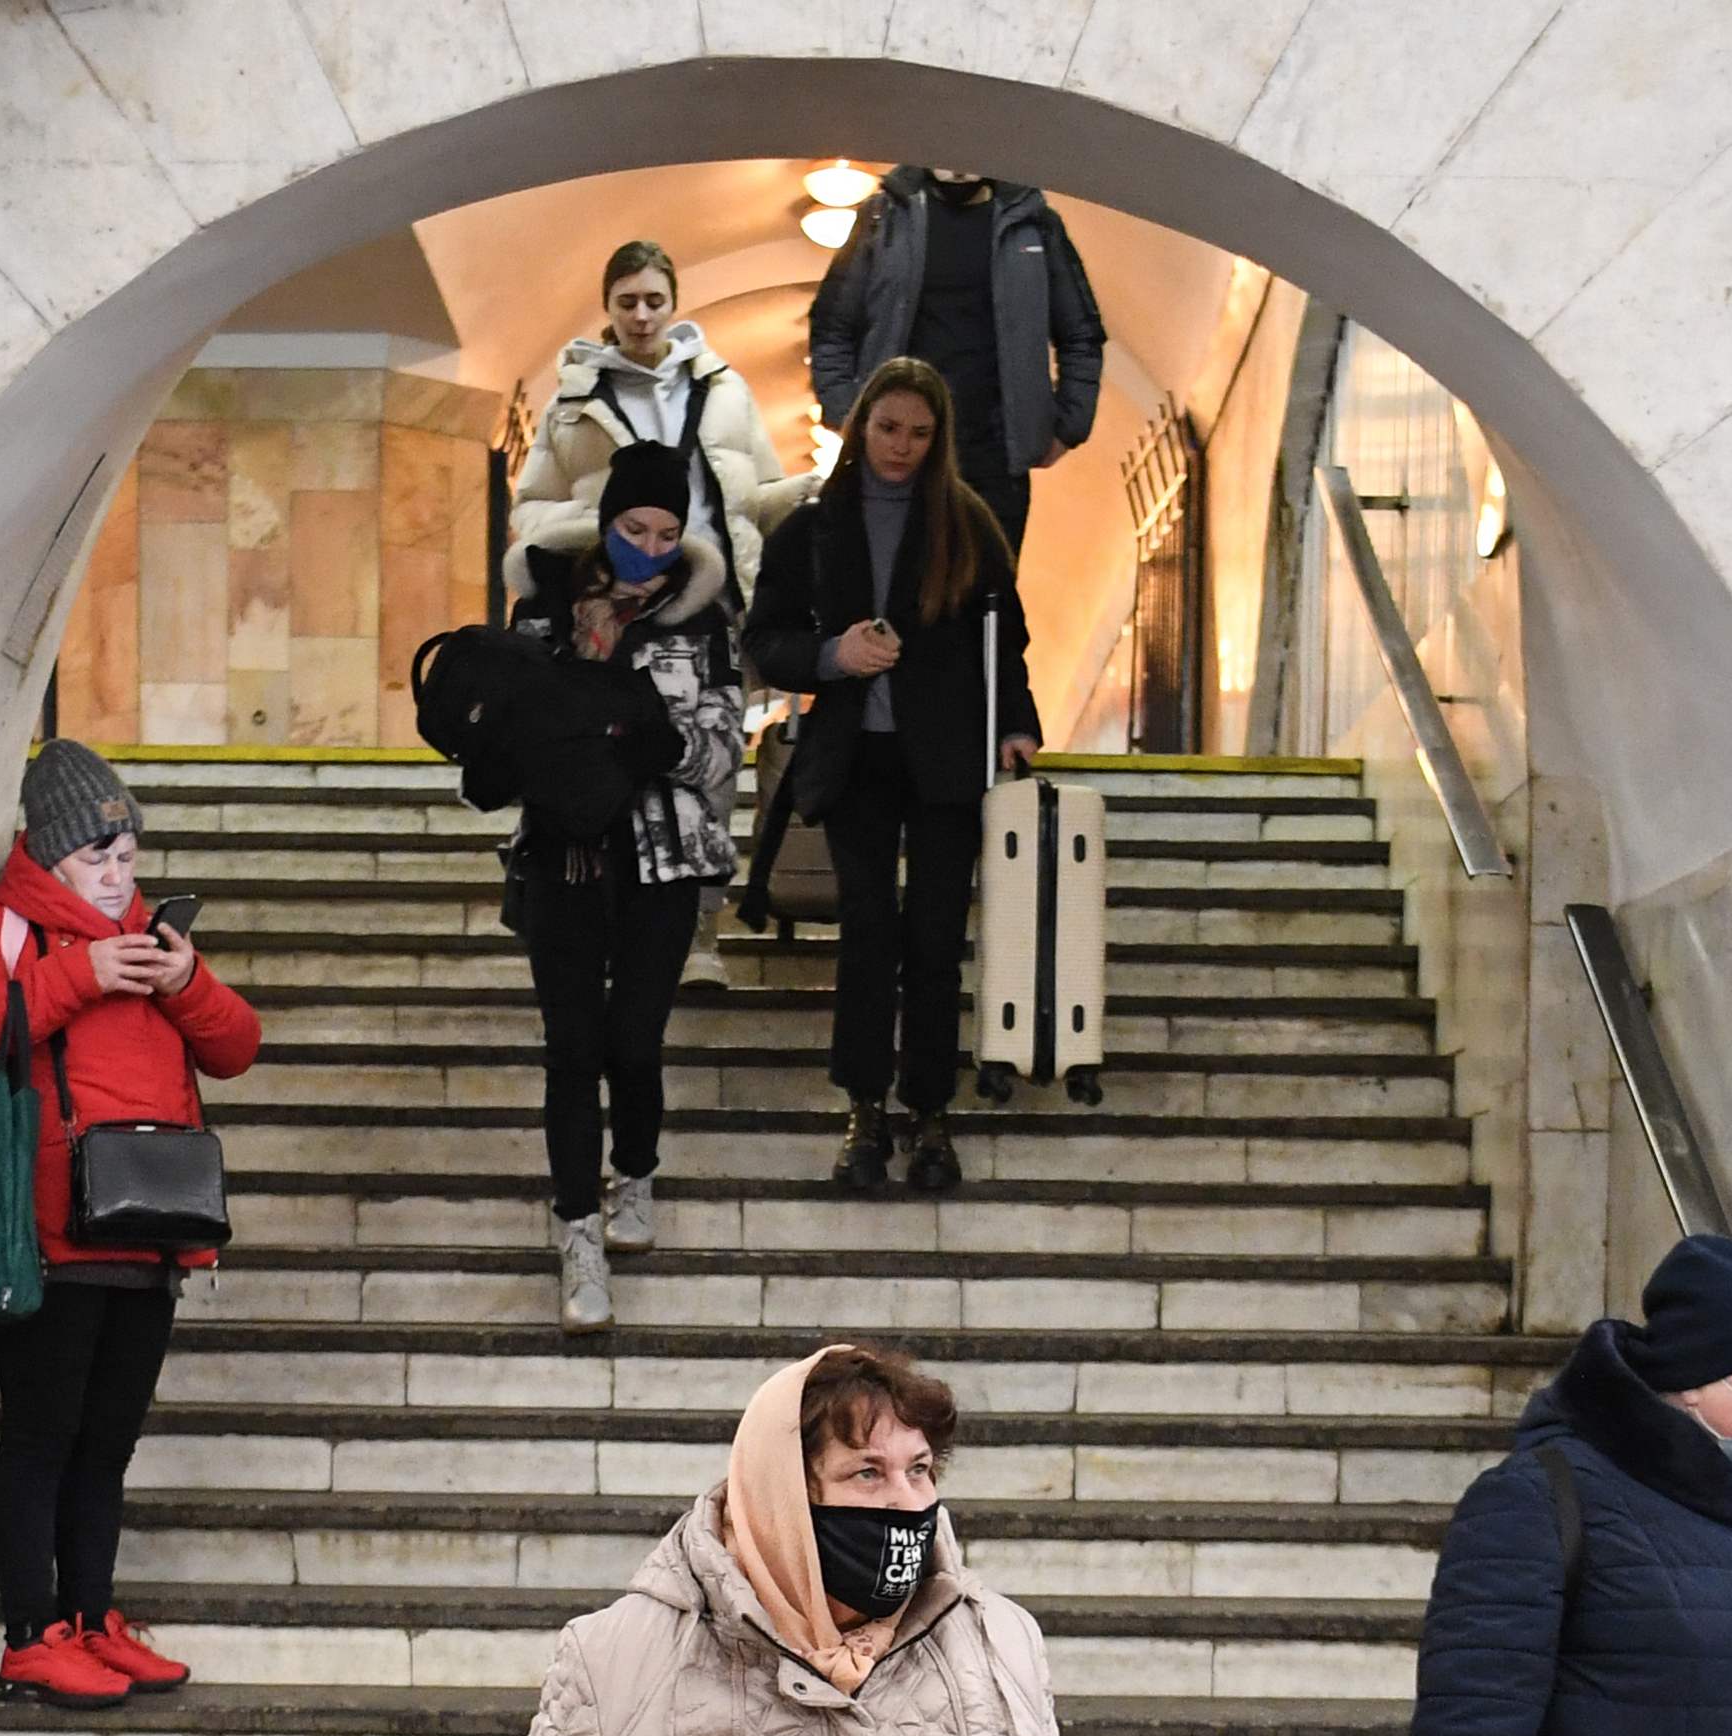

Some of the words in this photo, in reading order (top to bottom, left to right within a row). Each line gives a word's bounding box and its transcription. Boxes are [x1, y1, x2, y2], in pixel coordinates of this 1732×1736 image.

[890, 1526, 929, 1546] MIS
[889, 1544, 923, 1565] TER
[885, 1561, 922, 1583] CAT
